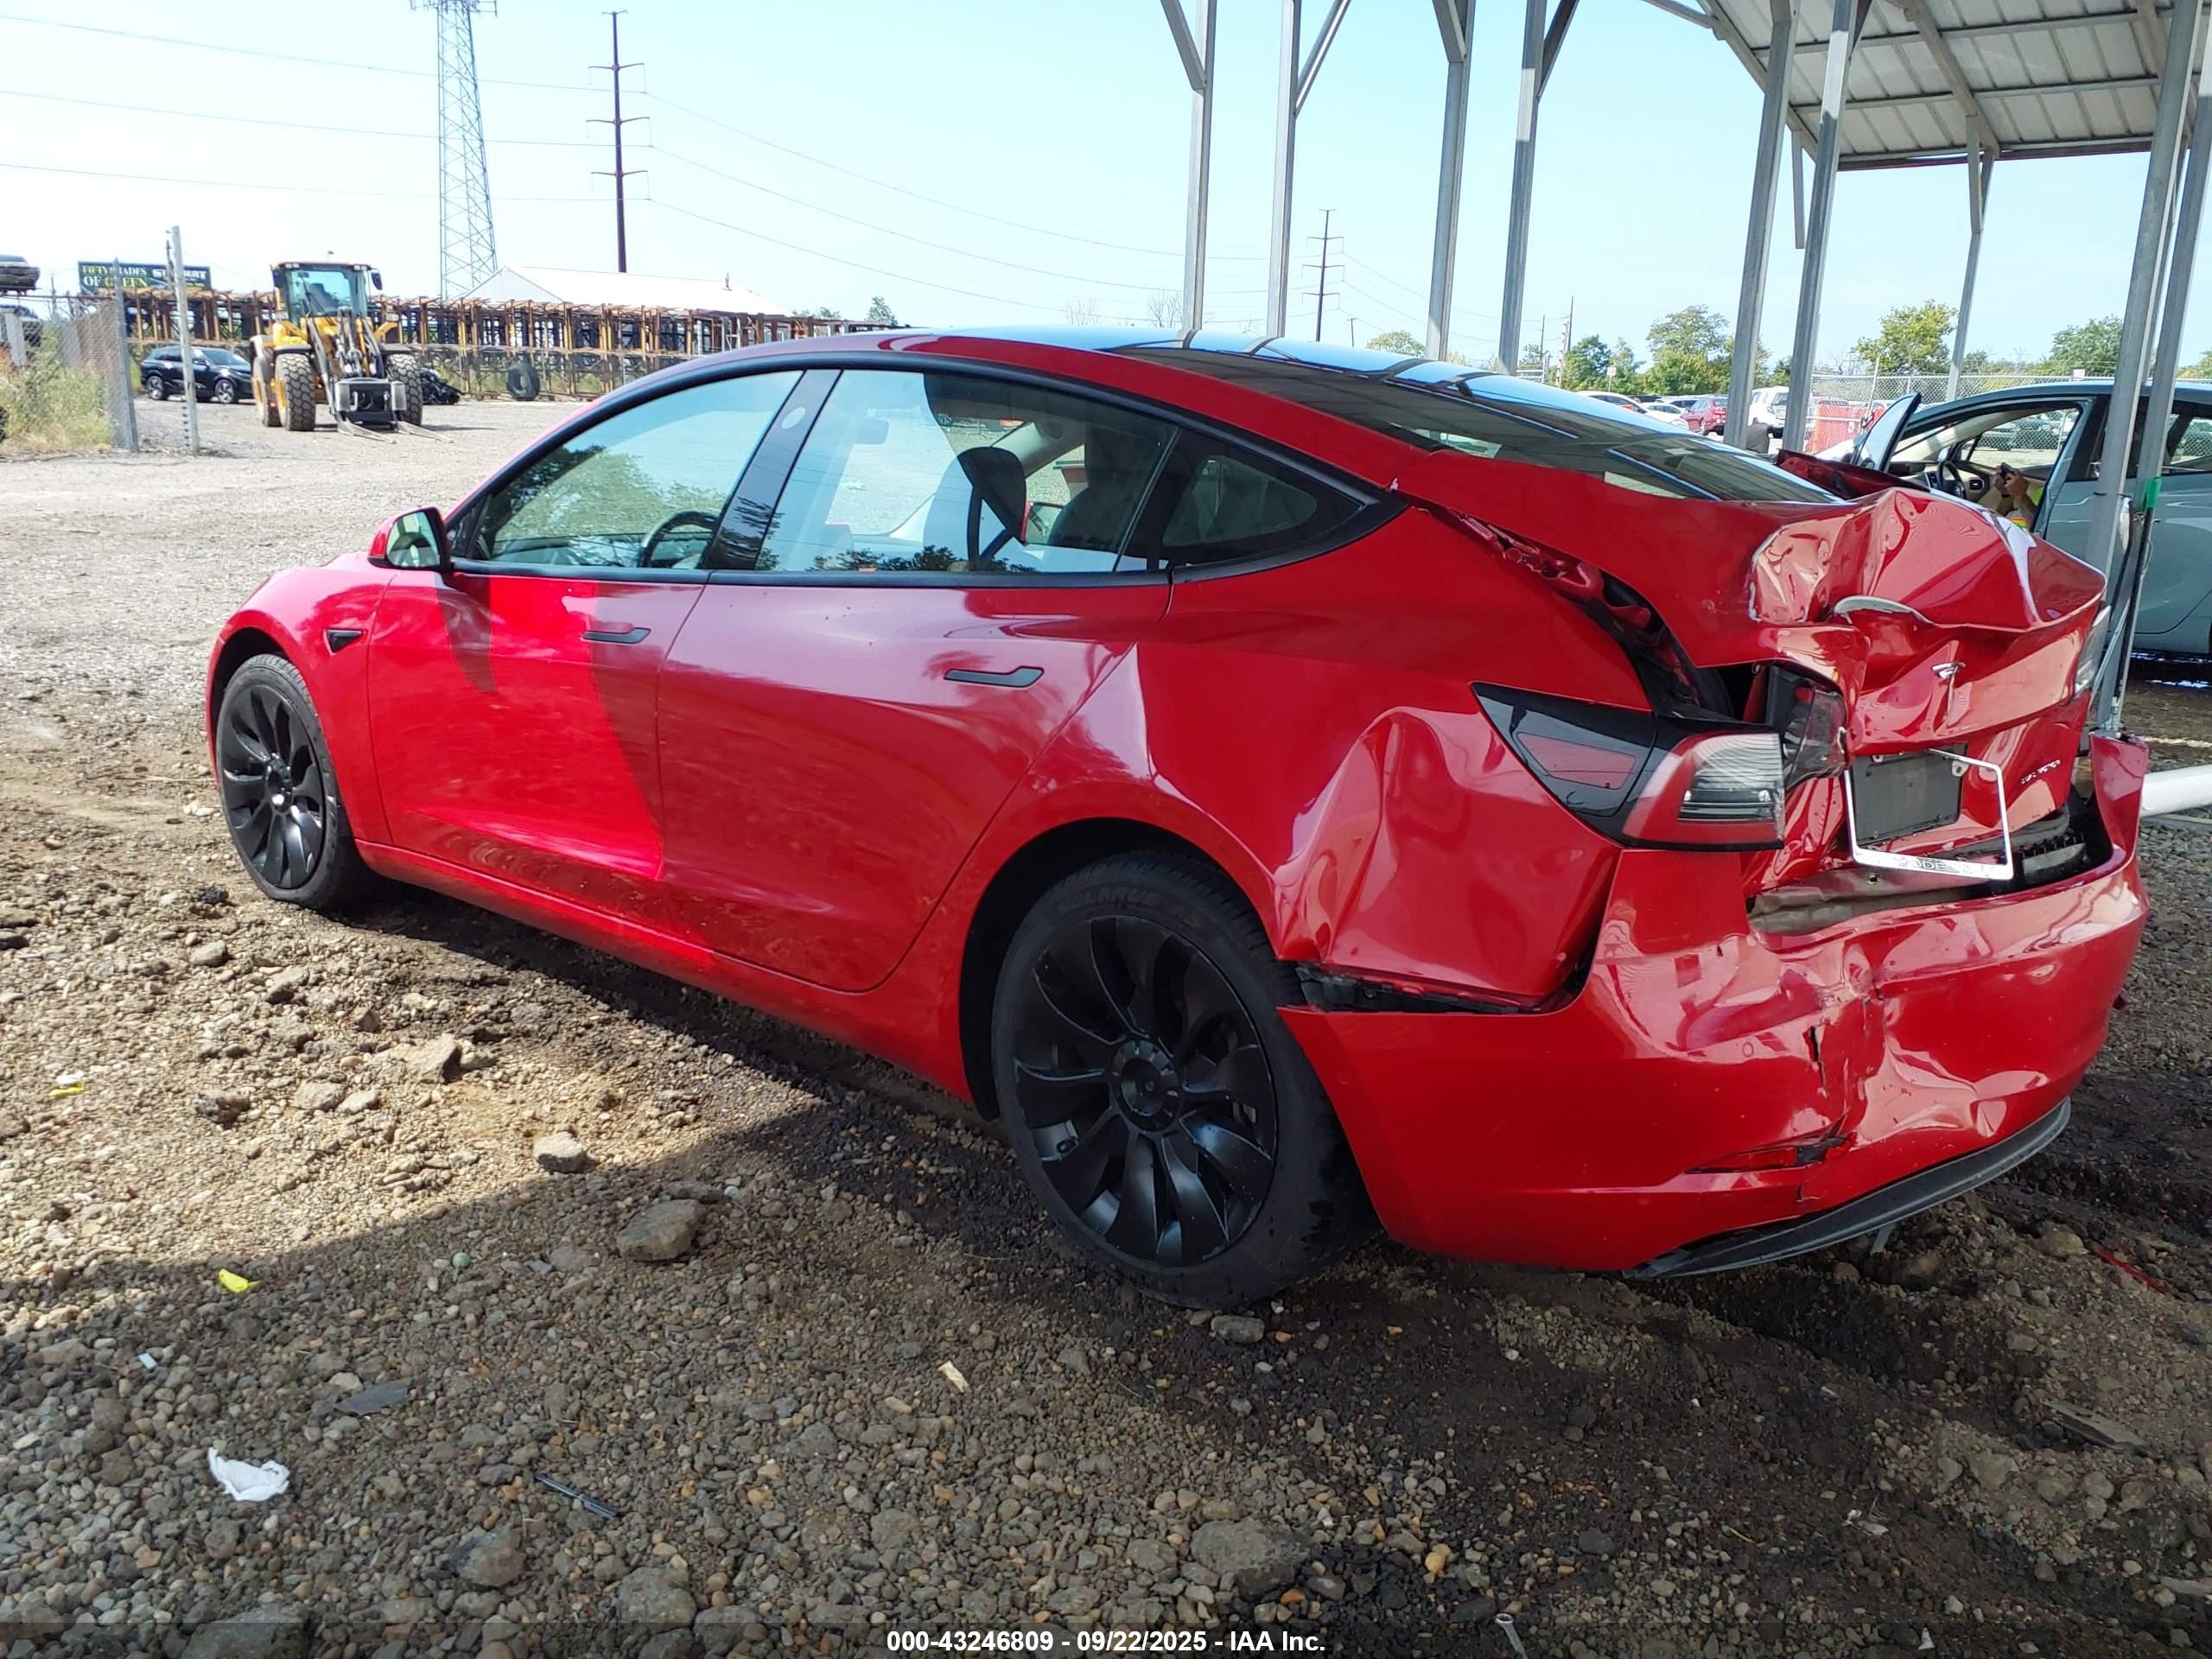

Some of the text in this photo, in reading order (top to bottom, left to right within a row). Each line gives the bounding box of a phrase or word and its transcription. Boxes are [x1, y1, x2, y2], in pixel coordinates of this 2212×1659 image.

[83, 265, 108, 274] FIFTY
[84, 276, 148, 288] OF GEEN
